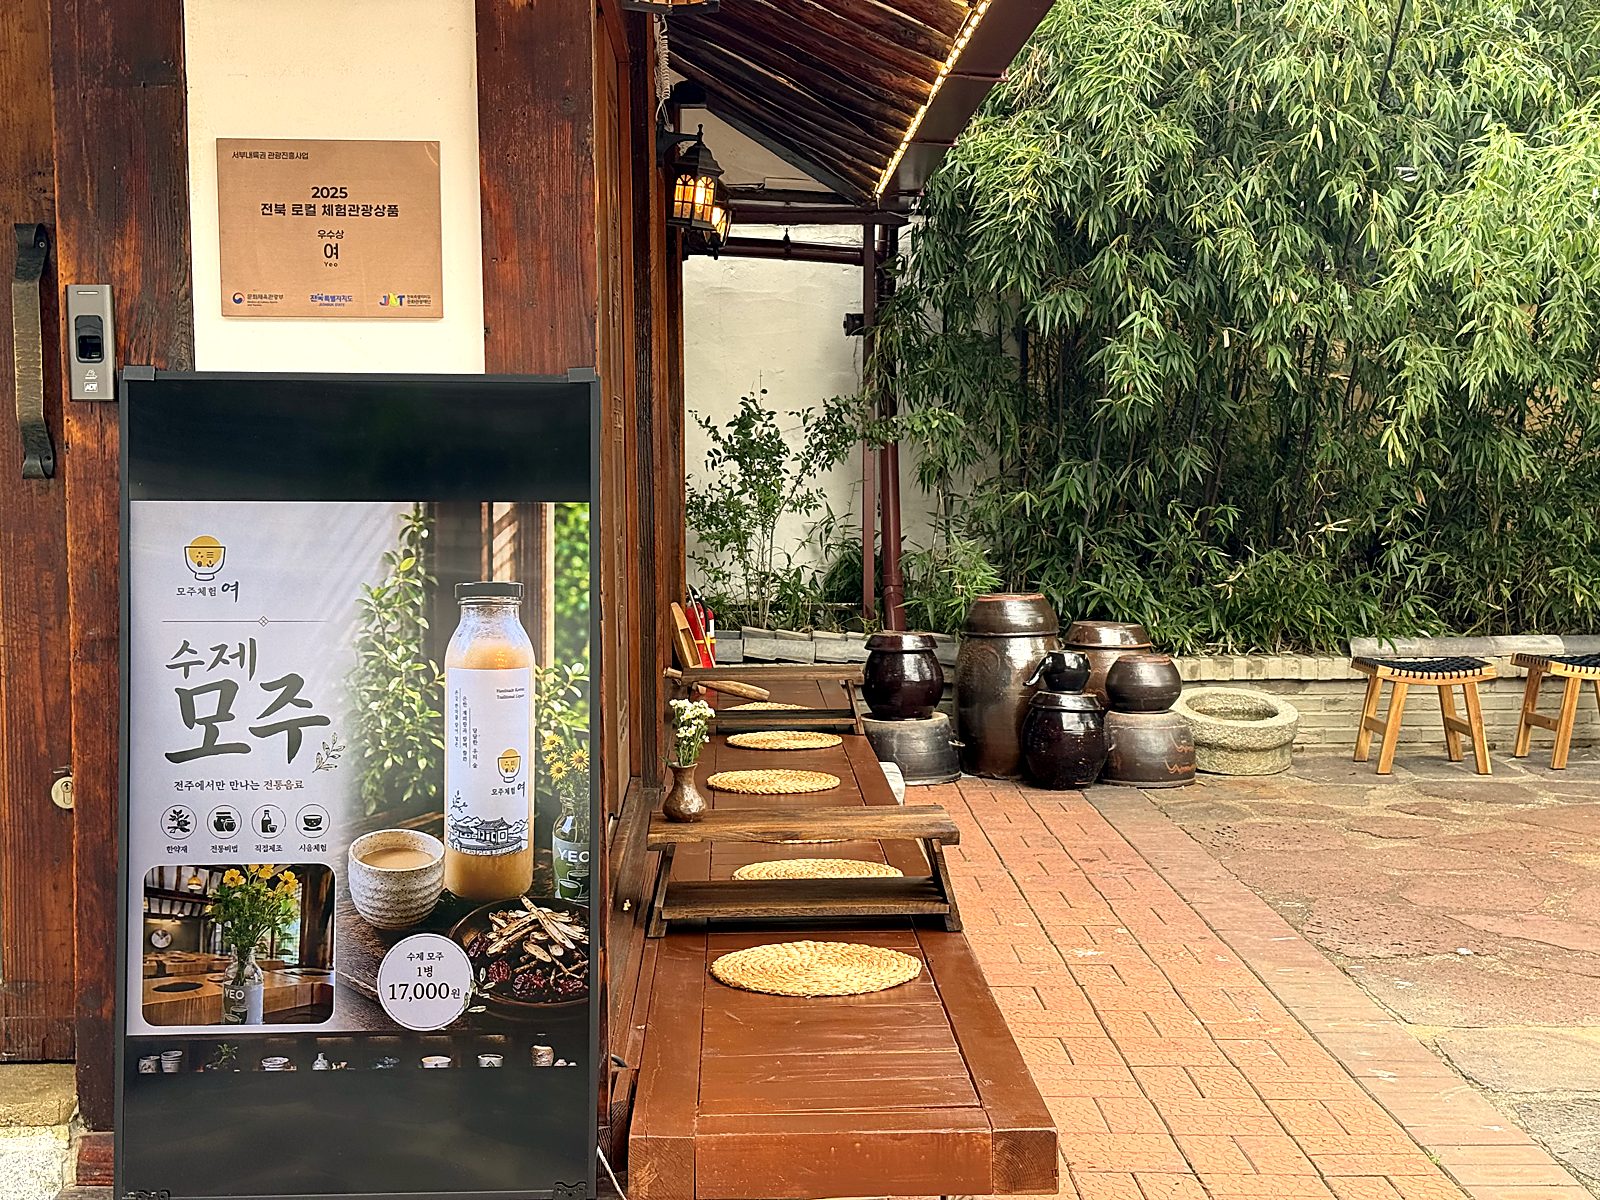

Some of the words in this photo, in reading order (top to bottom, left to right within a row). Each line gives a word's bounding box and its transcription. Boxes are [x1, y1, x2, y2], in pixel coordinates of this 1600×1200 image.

[232, 151, 267, 160] 서부내륙권
[268, 151, 309, 160] 관광진흥사업
[311, 186, 348, 199] 2025
[260, 203, 286, 217] 전북
[291, 203, 317, 217] 로컬
[321, 203, 399, 218] 체험관광상품
[317, 229, 345, 240] 우수상
[323, 242, 340, 260] 여
[176, 586, 217, 597] 모주체험
[221, 581, 239, 603] 여
[165, 637, 257, 681] 수제
[164, 672, 331, 764] 모주
[173, 779, 226, 791] 전주에서만
[229, 779, 260, 790] 만나는
[263, 778, 304, 790] 전통음료
[166, 845, 188, 854] 한약재
[210, 845, 238, 854] 전통비법
[254, 844, 283, 853] 직접제조
[298, 844, 327, 853] 시음체험
[406, 952, 424, 962] 수제
[426, 951, 444, 962] 모주
[416, 966, 433, 978] 1병
[224, 988, 245, 1000] YEO
